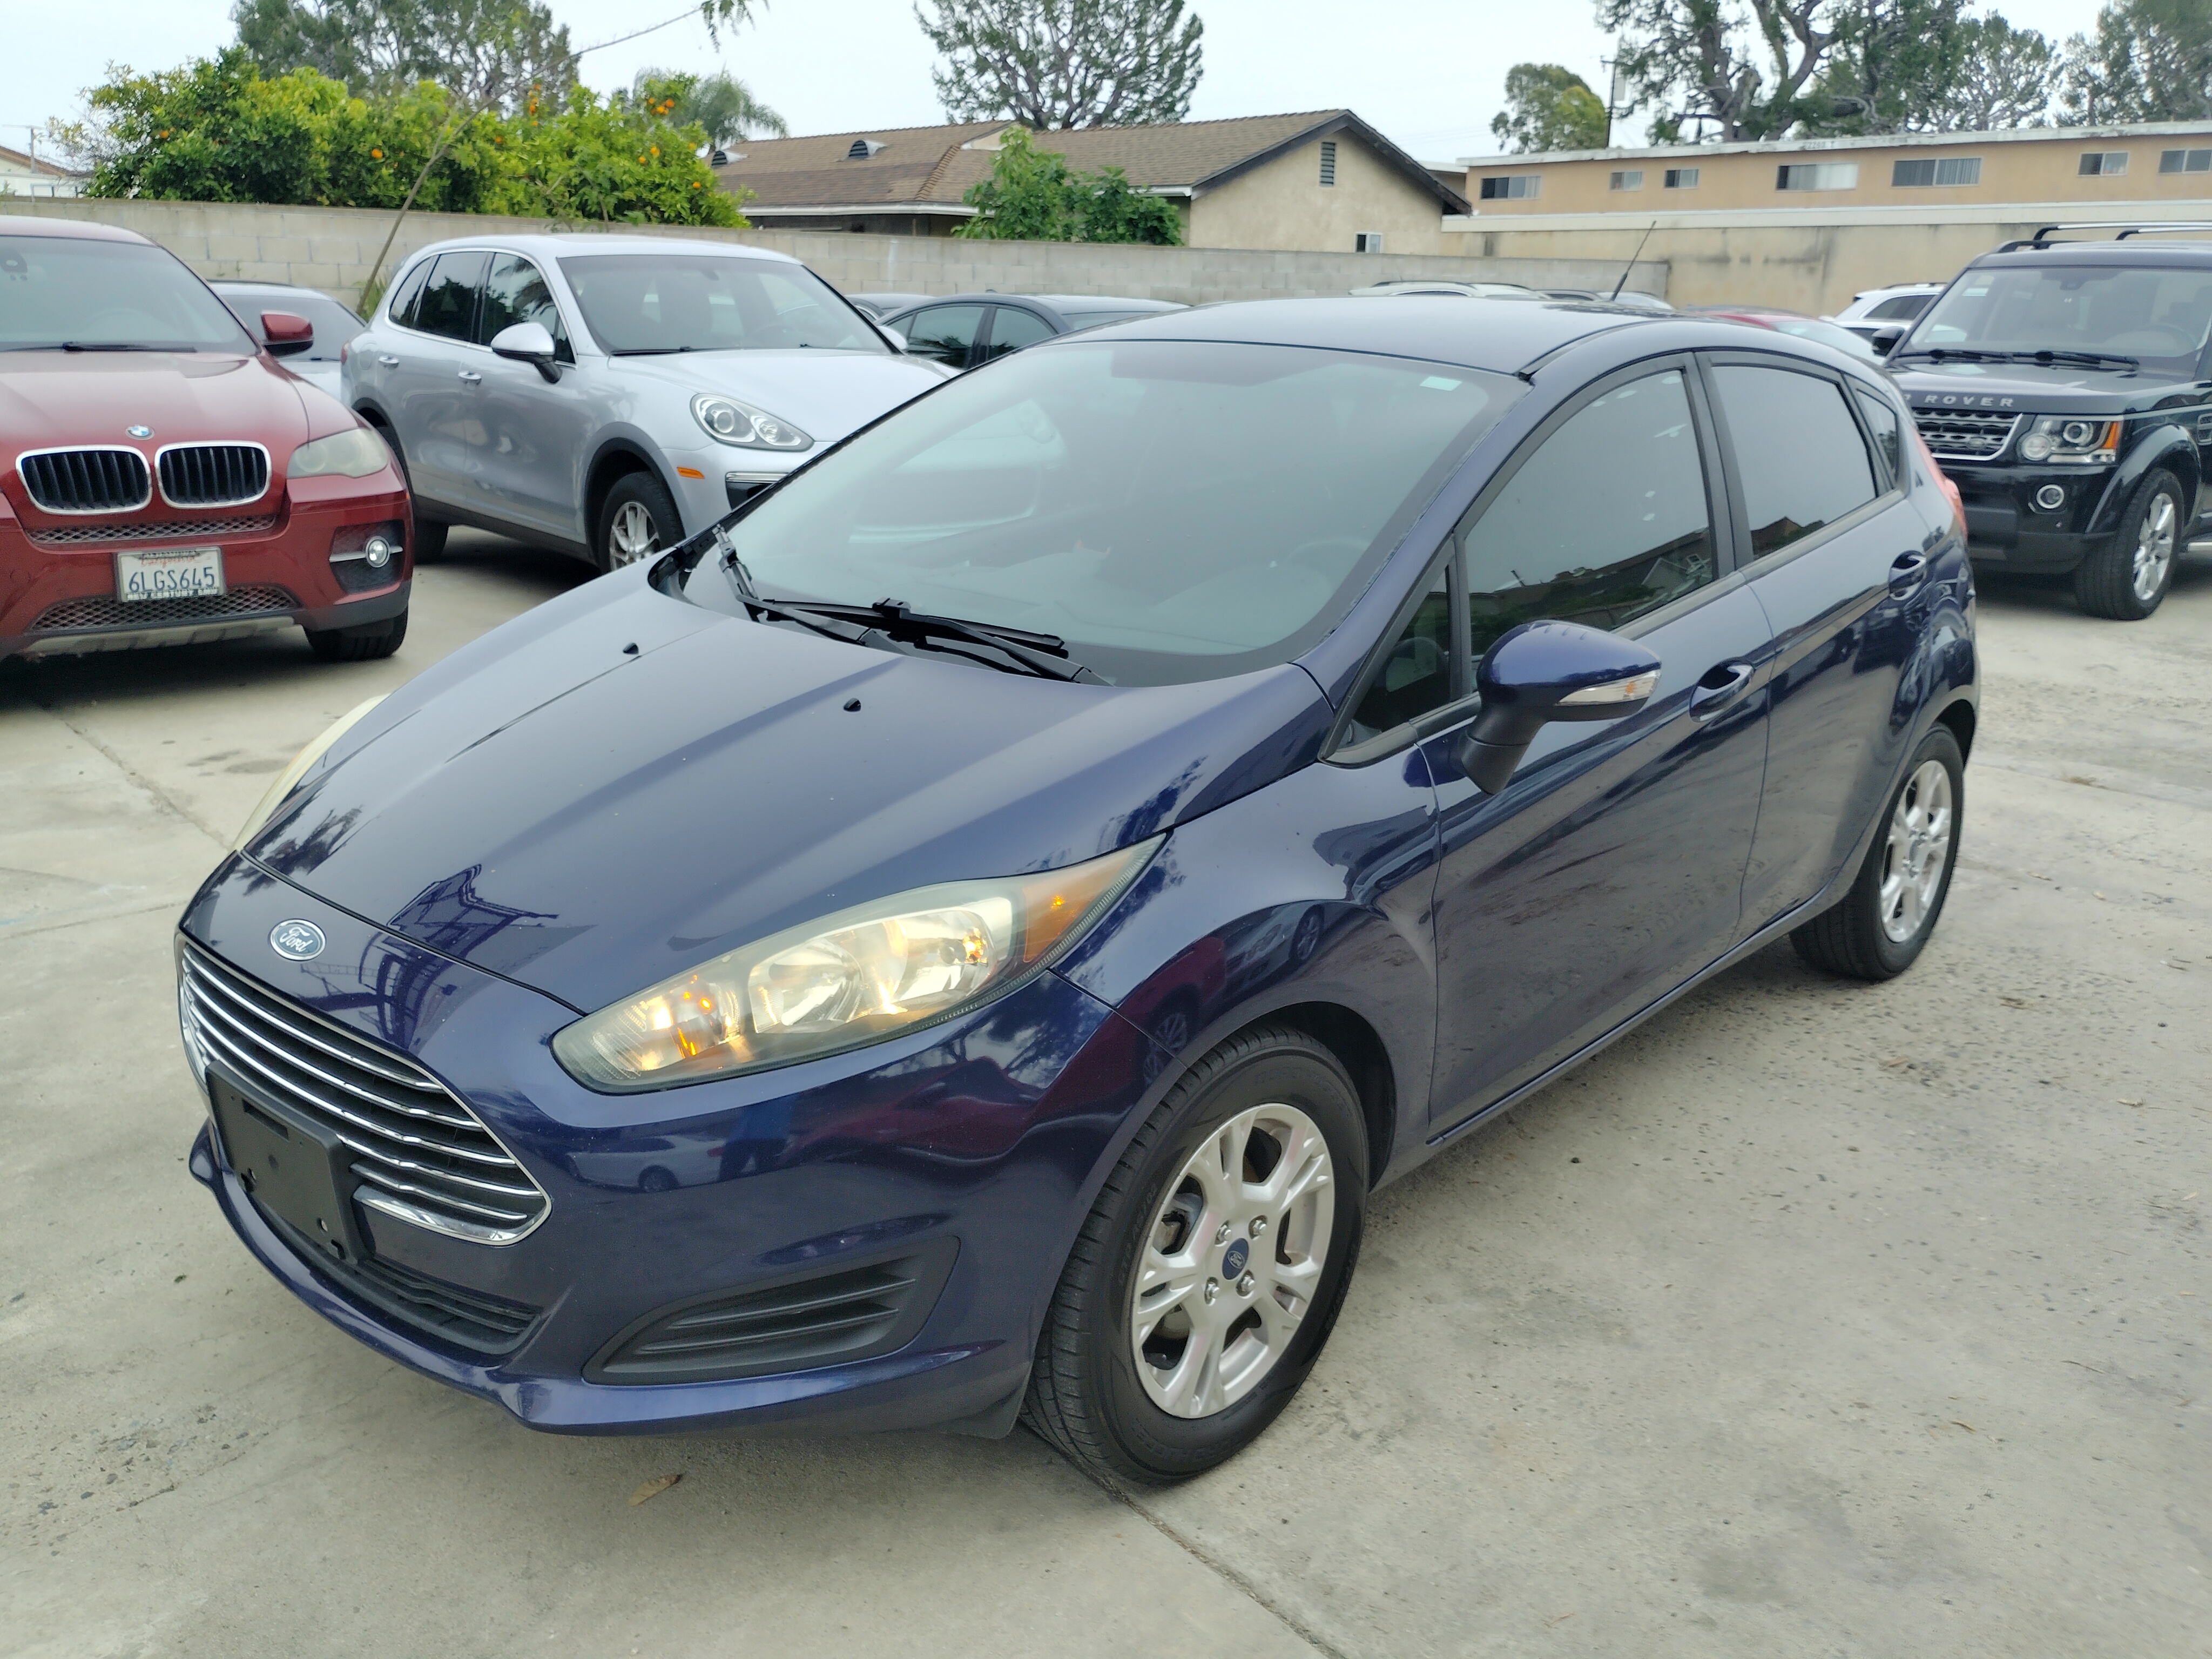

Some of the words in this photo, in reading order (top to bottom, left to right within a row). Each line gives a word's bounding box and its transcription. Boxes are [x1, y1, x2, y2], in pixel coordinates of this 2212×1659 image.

[1924, 394, 2014, 408] ROVER
[129, 567, 214, 593] 6LGS645
[279, 926, 314, 953] Ford
